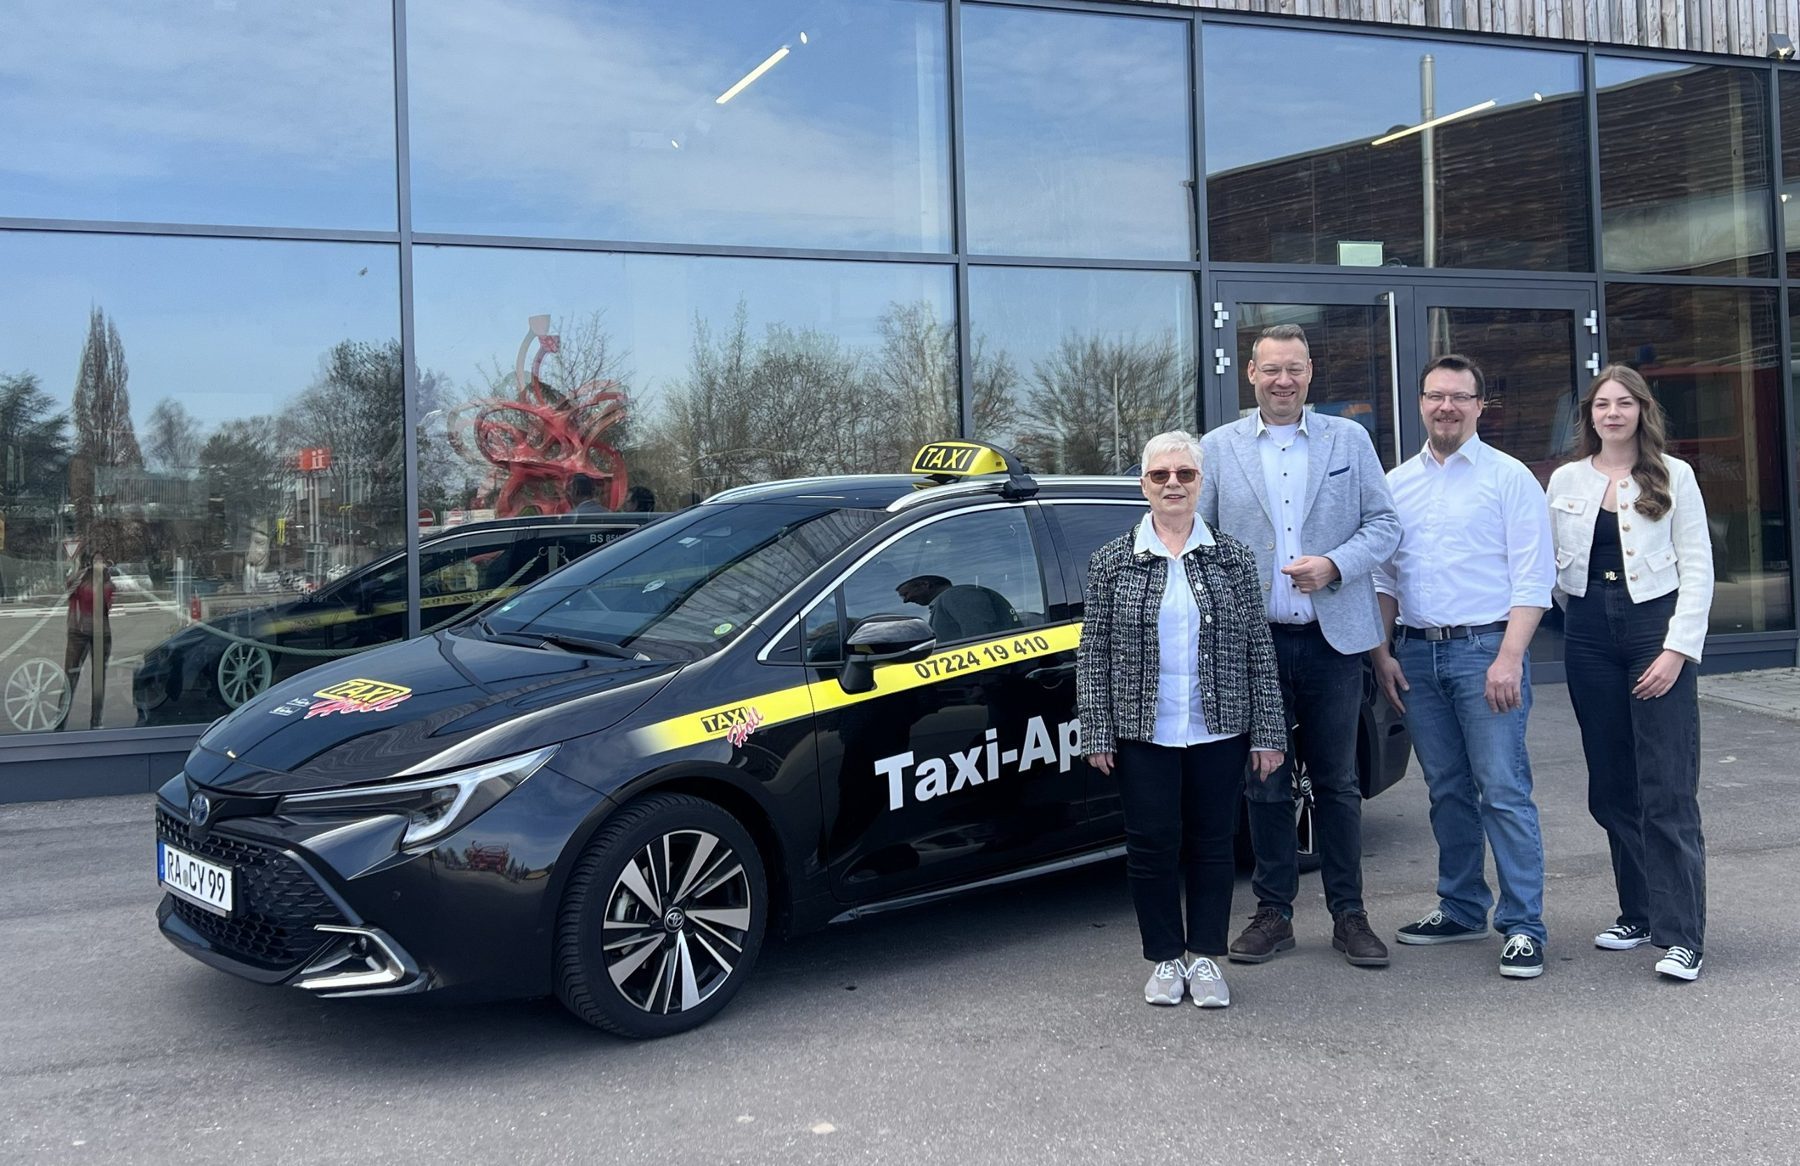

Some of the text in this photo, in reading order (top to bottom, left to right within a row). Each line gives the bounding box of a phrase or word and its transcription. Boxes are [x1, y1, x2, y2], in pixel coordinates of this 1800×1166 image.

[922, 448, 973, 469] TAXI
[914, 636, 1049, 679] 07224 19 410
[330, 681, 401, 704] TAXI
[702, 707, 750, 731] TAXI
[167, 850, 225, 902] RA CY 99
